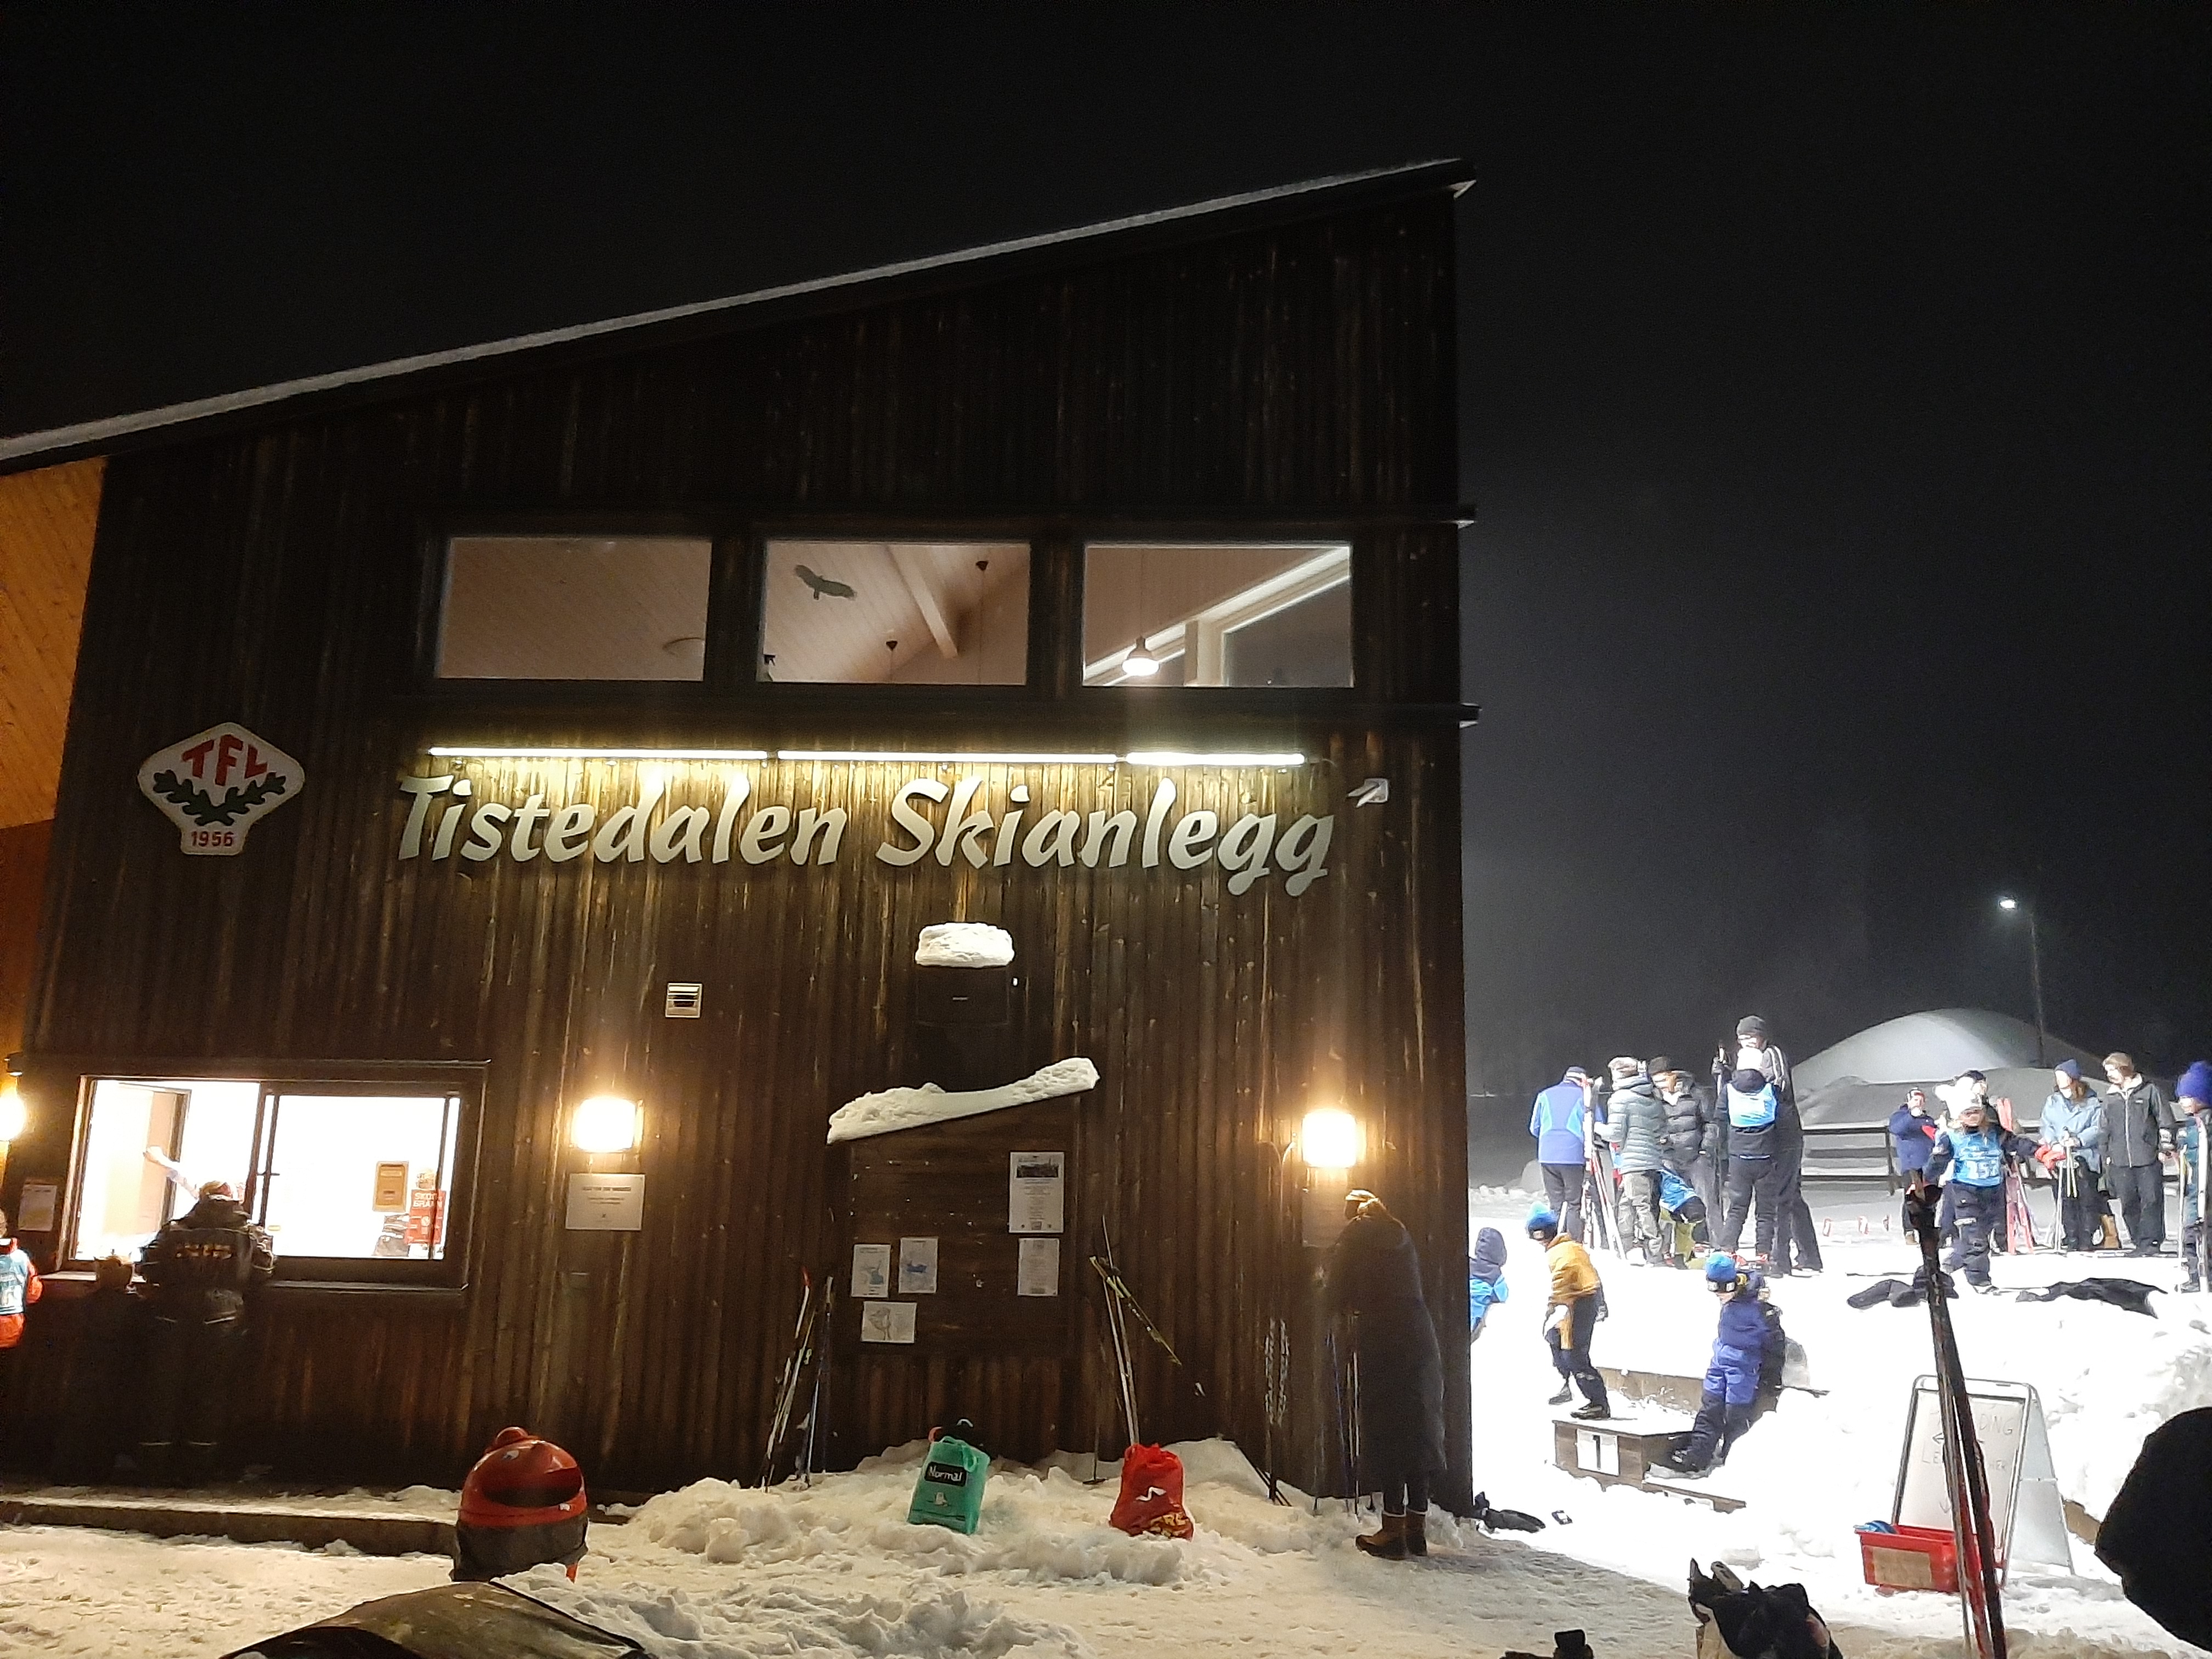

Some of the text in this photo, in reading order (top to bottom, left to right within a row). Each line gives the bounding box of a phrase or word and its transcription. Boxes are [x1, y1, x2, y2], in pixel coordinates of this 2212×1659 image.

[181, 734, 268, 787] TFL
[191, 831, 234, 847] 1956
[398, 770, 1334, 896] Tistedalen Skianlegg
[929, 1465, 963, 1481] Normal
